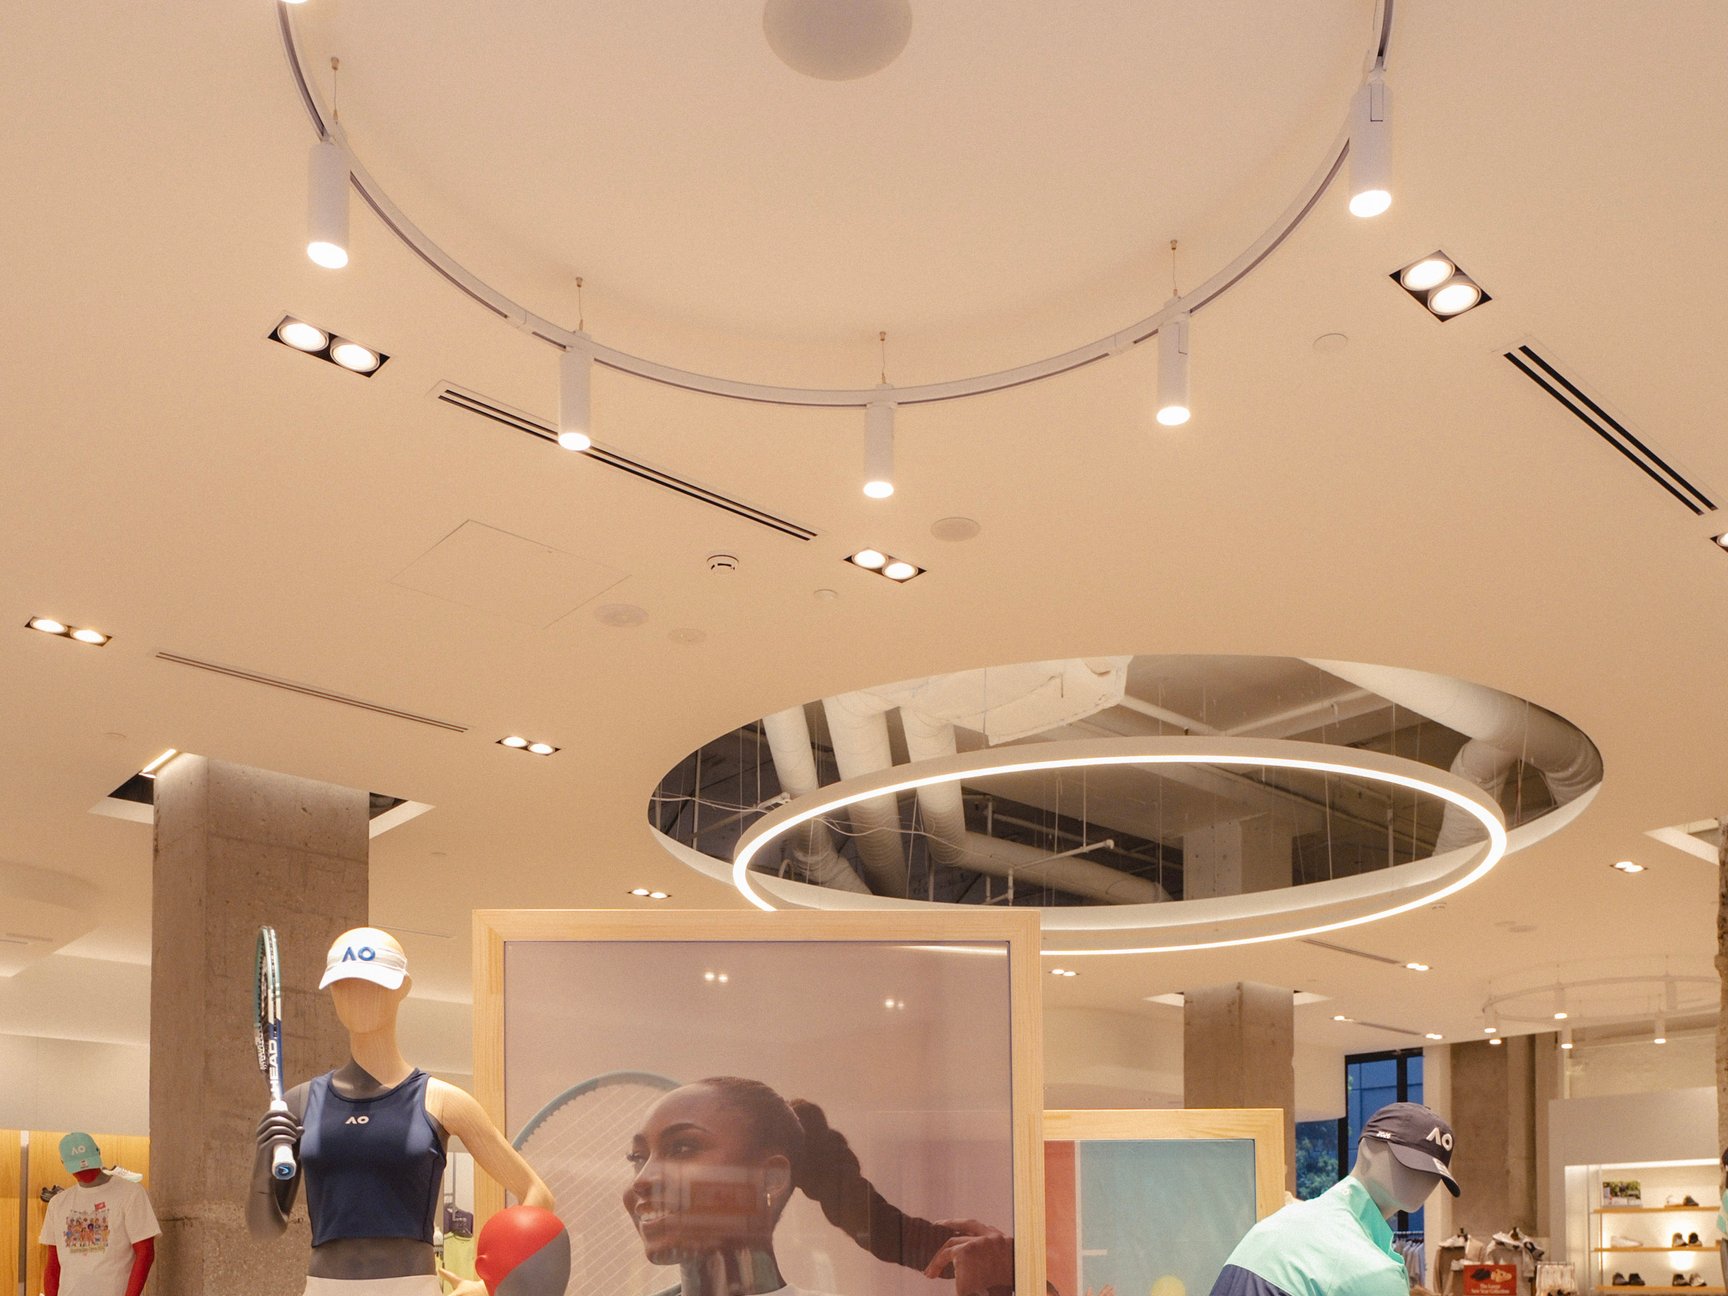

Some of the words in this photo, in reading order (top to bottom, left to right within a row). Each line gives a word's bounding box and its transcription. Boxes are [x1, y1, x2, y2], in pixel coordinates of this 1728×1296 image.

[341, 946, 376, 962] AO
[268, 1039, 280, 1093] HEAD
[345, 1115, 369, 1125] AO
[1425, 1127, 1453, 1152] AO
